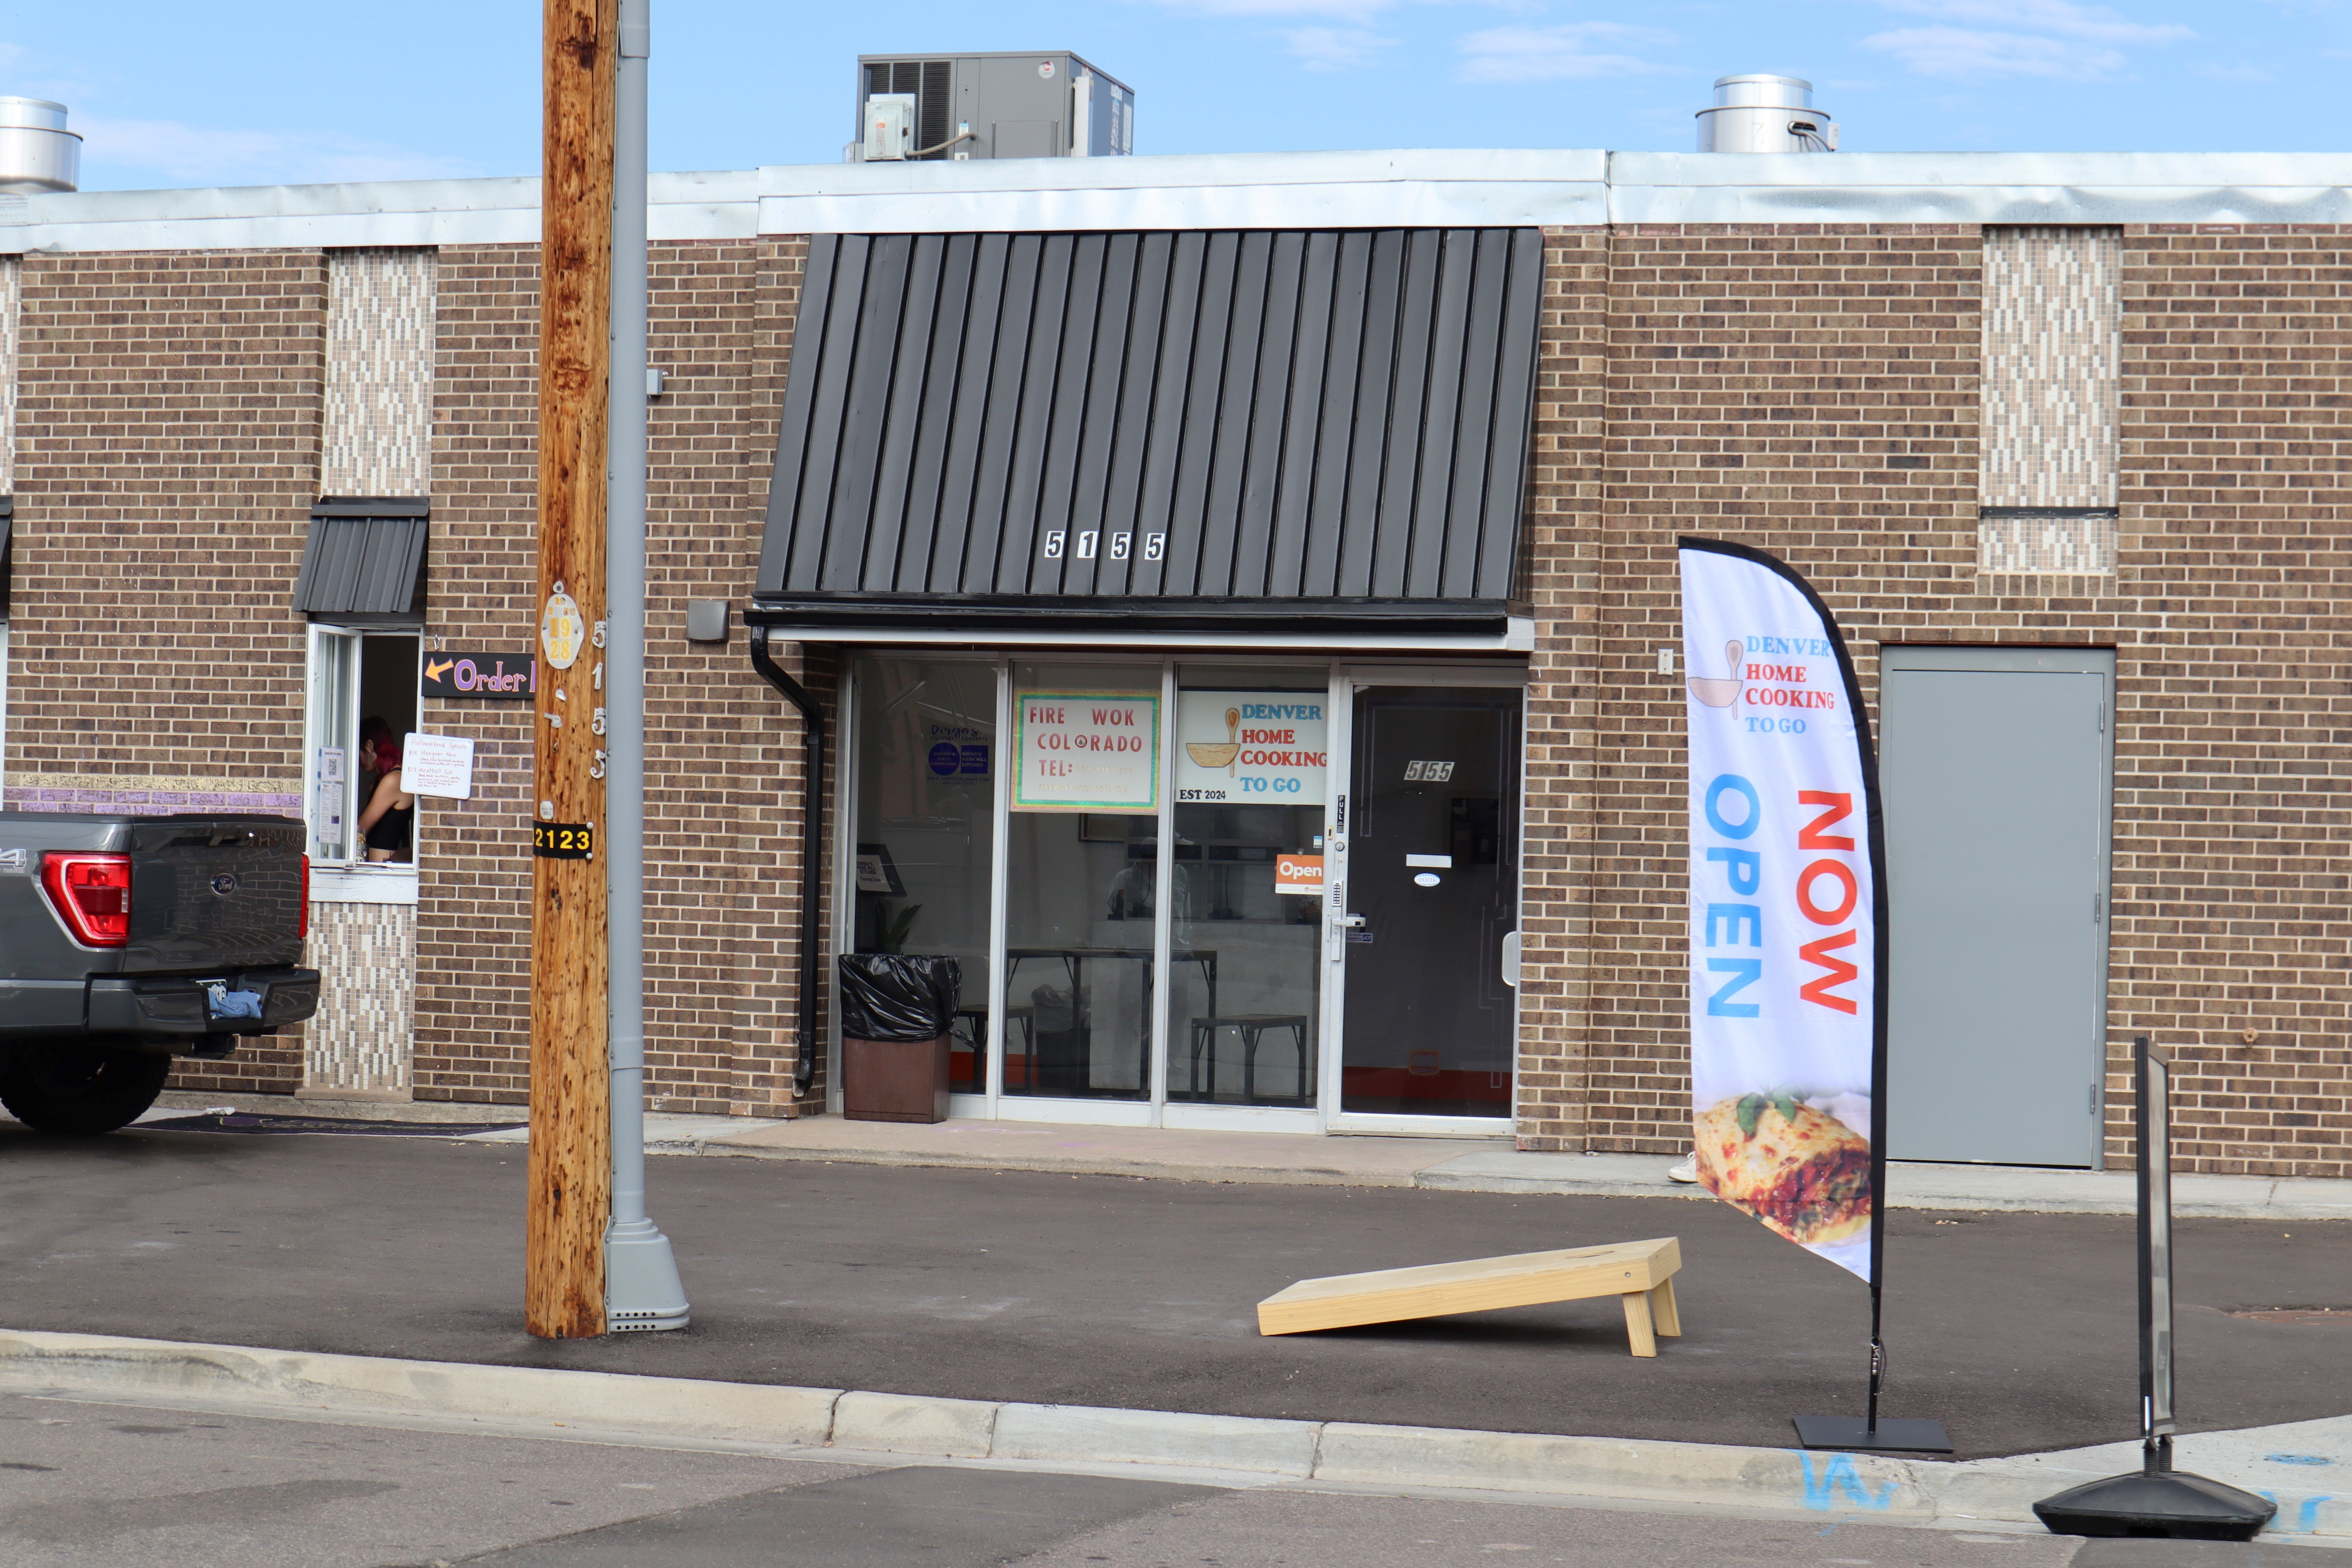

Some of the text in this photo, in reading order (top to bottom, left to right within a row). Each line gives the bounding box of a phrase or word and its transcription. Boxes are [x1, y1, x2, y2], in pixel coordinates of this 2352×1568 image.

[1047, 532, 1161, 559] 5155
[550, 640, 570, 659] 28
[1746, 635, 1830, 657] DENVER
[454, 659, 527, 692] Order
[1745, 663, 1807, 683] HOME
[1745, 688, 1835, 710] COOKING
[1030, 706, 1065, 724] FIRE
[1091, 708, 1134, 726] WOK
[1241, 704, 1322, 720] DENVER
[1037, 733, 1142, 753] COLORADO
[1241, 729, 1295, 744] HOME
[1038, 759, 1073, 777] TEL:
[1241, 750, 1327, 767] COOKING
[1406, 761, 1452, 780] 5155
[1180, 789, 1226, 800] EST 2024
[1240, 777, 1301, 793] TO GO
[535, 828, 590, 850] 2123
[1279, 861, 1322, 880] Open
[1705, 773, 1762, 1018] OPEN
[1796, 790, 1858, 1016] NOW
